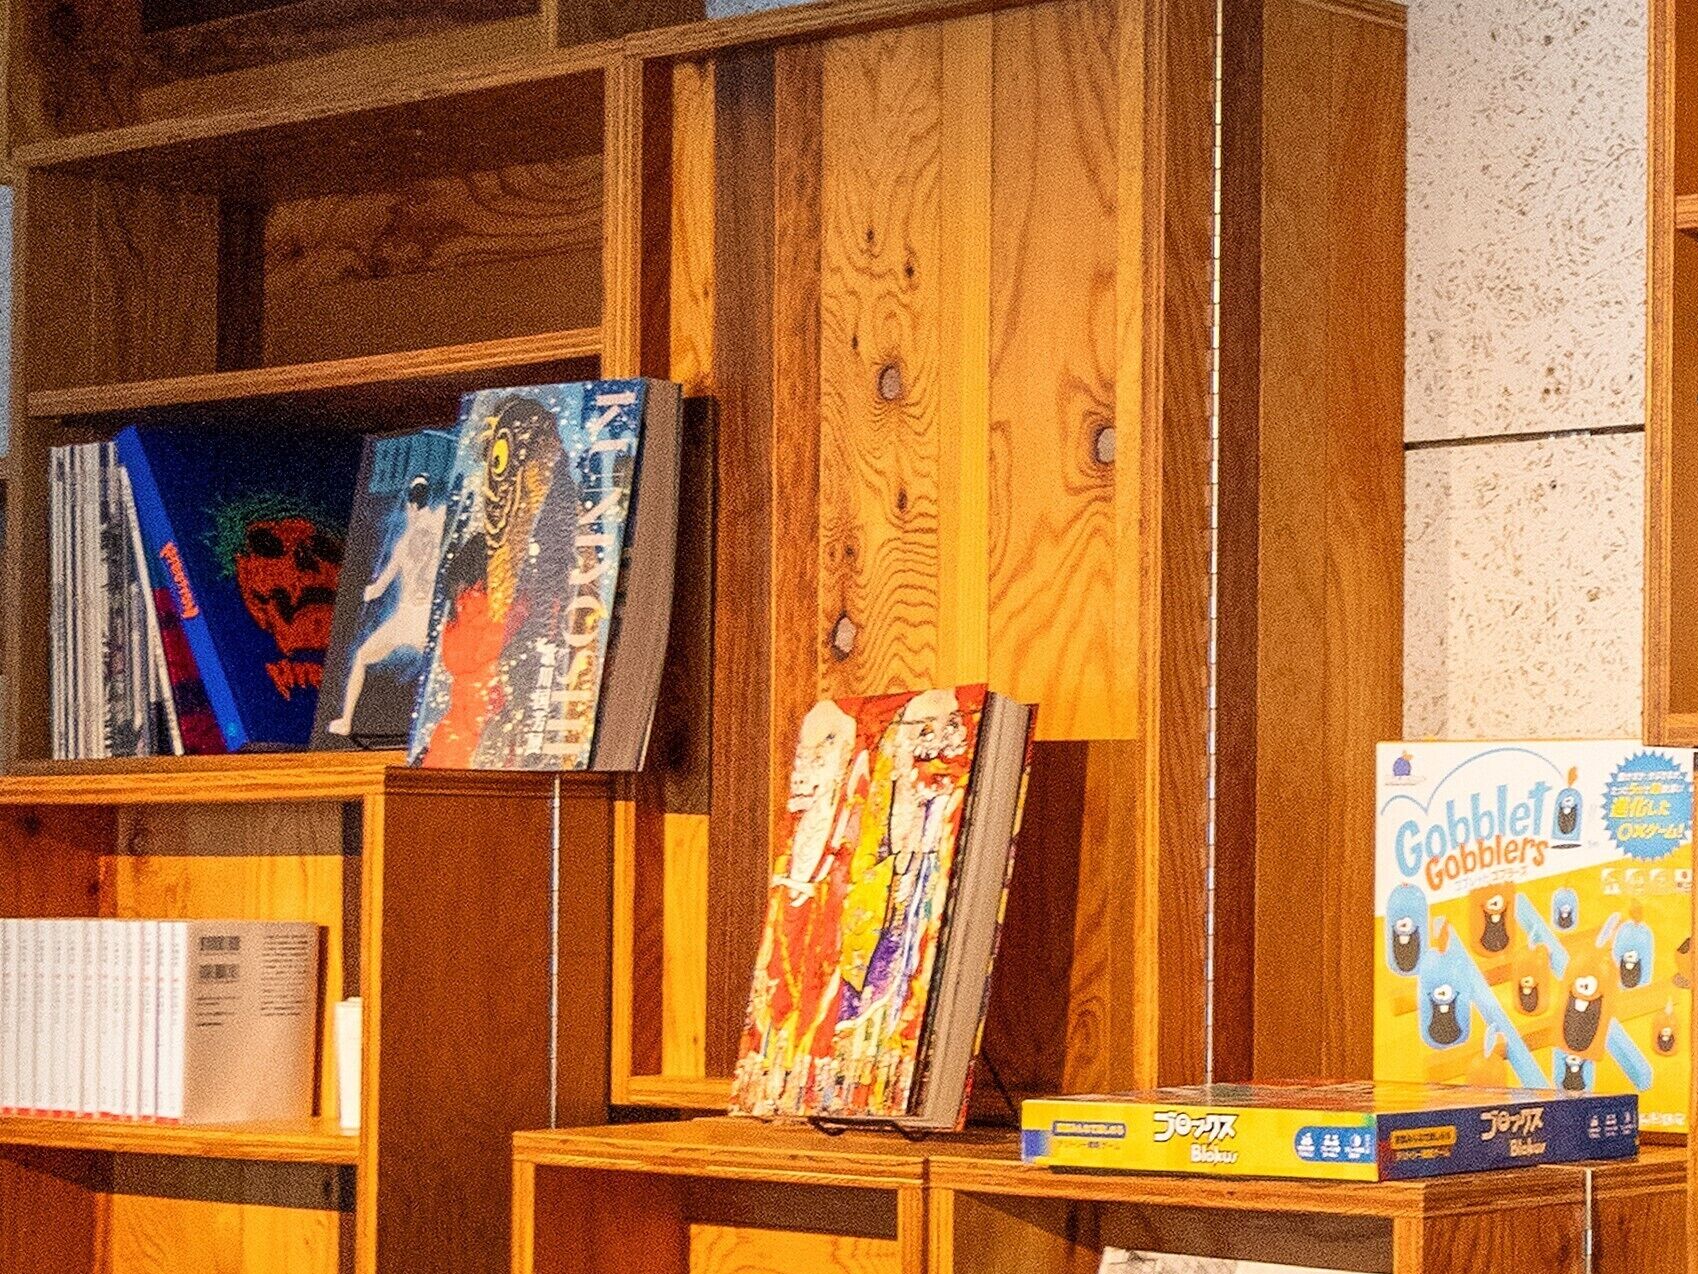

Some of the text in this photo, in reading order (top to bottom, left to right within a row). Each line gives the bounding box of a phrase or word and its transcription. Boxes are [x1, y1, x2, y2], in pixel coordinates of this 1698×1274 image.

[541, 390, 638, 756] KUNIYOSHI
[1396, 781, 1552, 877] Gobblet
[1425, 835, 1550, 890] Gobblers
[1153, 1112, 1238, 1143] ブロックス
[1481, 1107, 1545, 1143] ブロックス
[1191, 1143, 1239, 1165] Blokus
